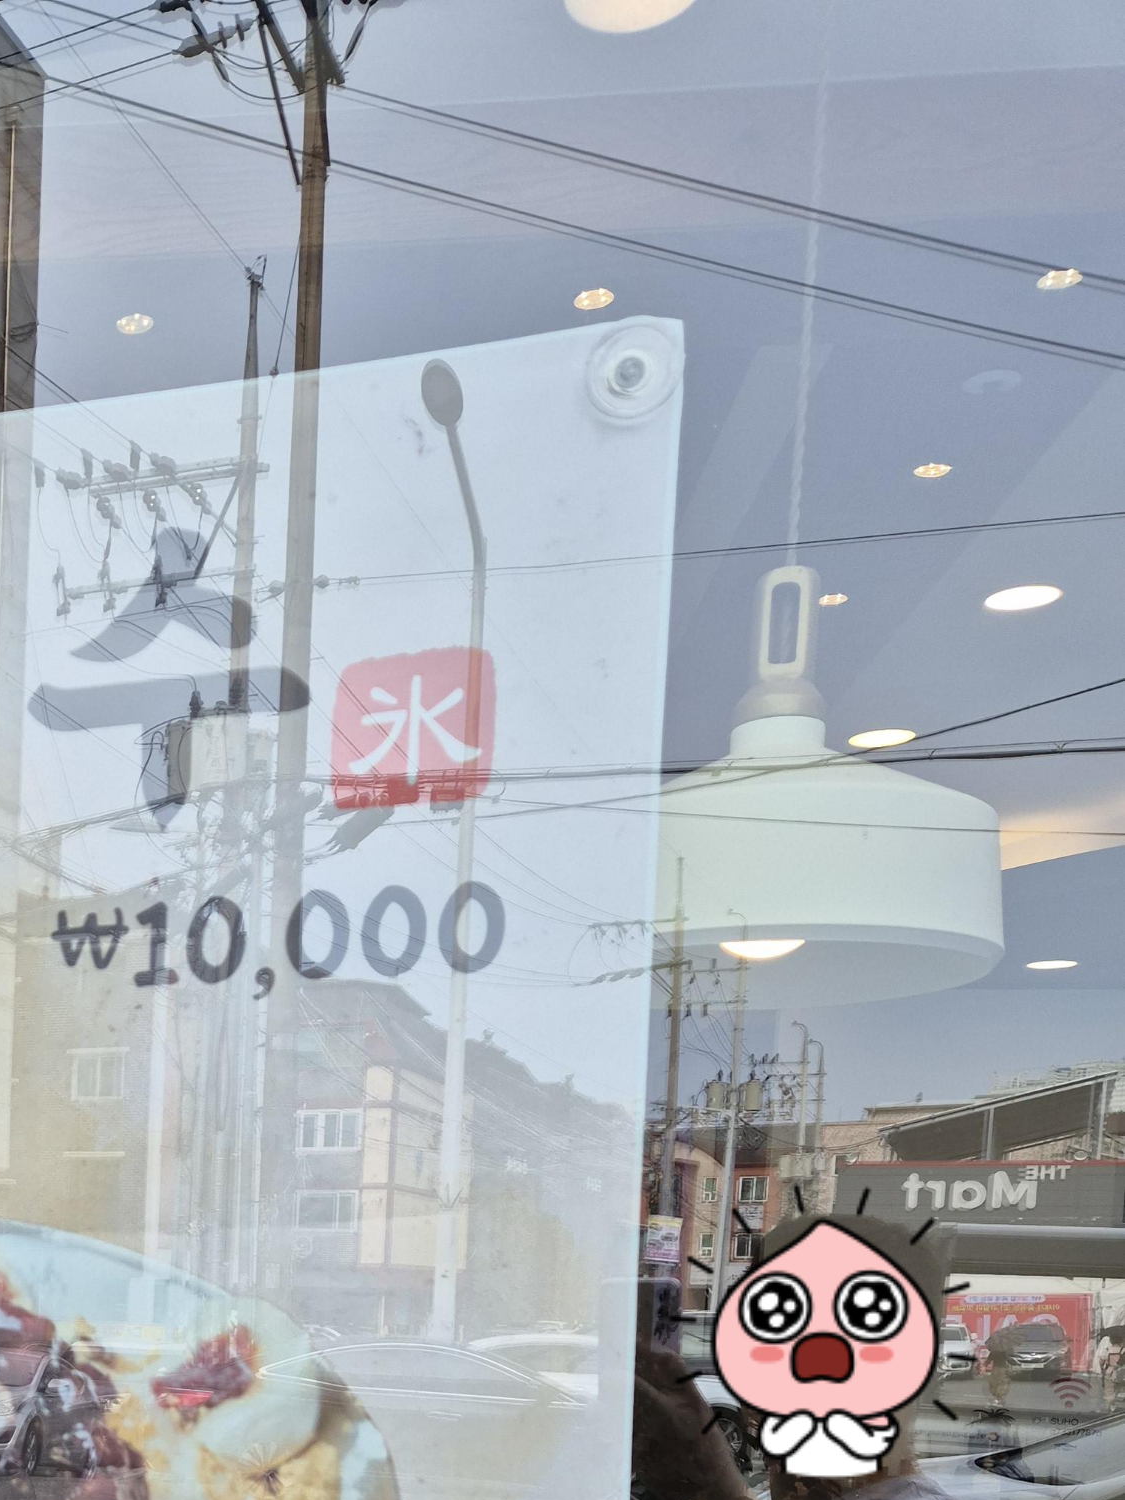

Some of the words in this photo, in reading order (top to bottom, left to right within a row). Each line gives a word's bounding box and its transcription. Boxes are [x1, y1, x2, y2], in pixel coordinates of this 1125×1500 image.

[349, 675, 483, 785] 氷
[51, 881, 506, 999] ₩10,000
[1049, 1416, 1079, 1426] SUHO
